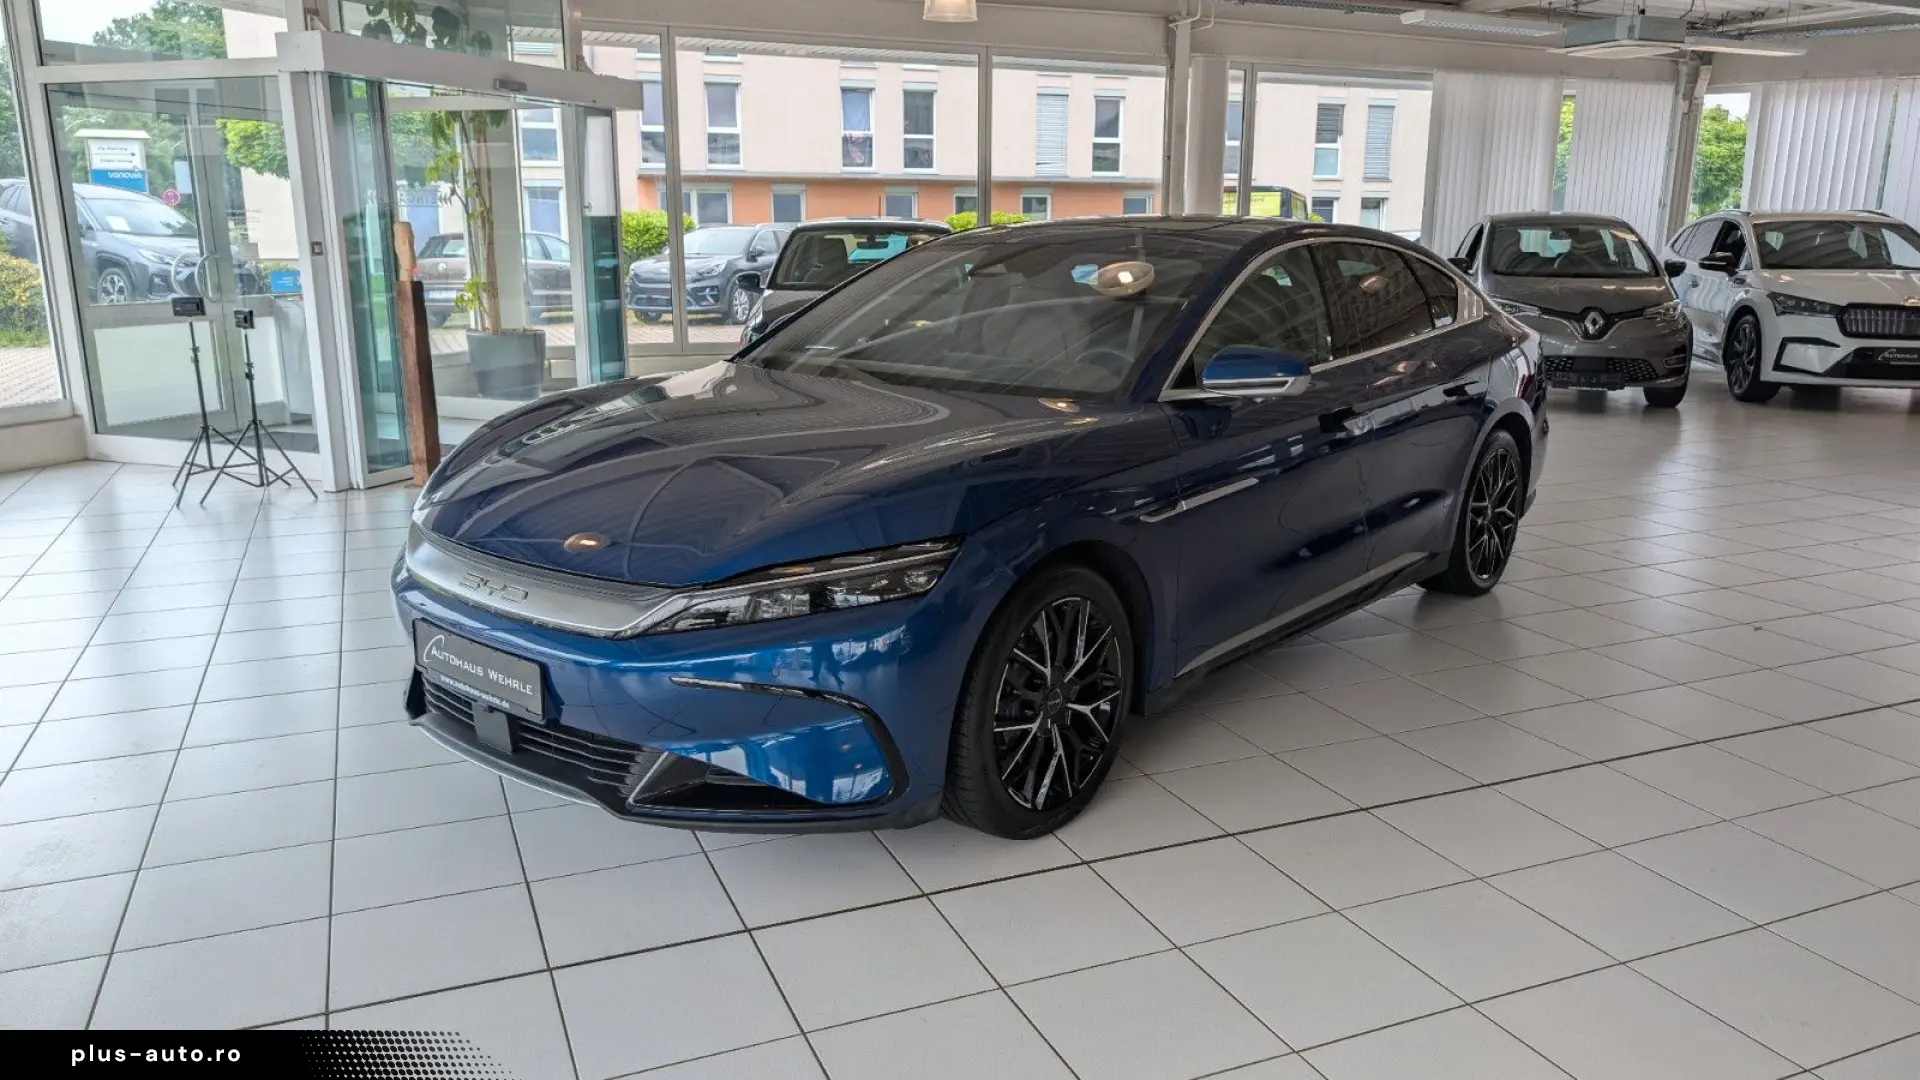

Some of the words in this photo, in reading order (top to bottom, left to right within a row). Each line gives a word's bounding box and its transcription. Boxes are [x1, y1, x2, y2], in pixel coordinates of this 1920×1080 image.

[460, 572, 529, 603] BYD
[429, 643, 484, 677] AUTOHAUS
[487, 667, 533, 695] WEHRLE
